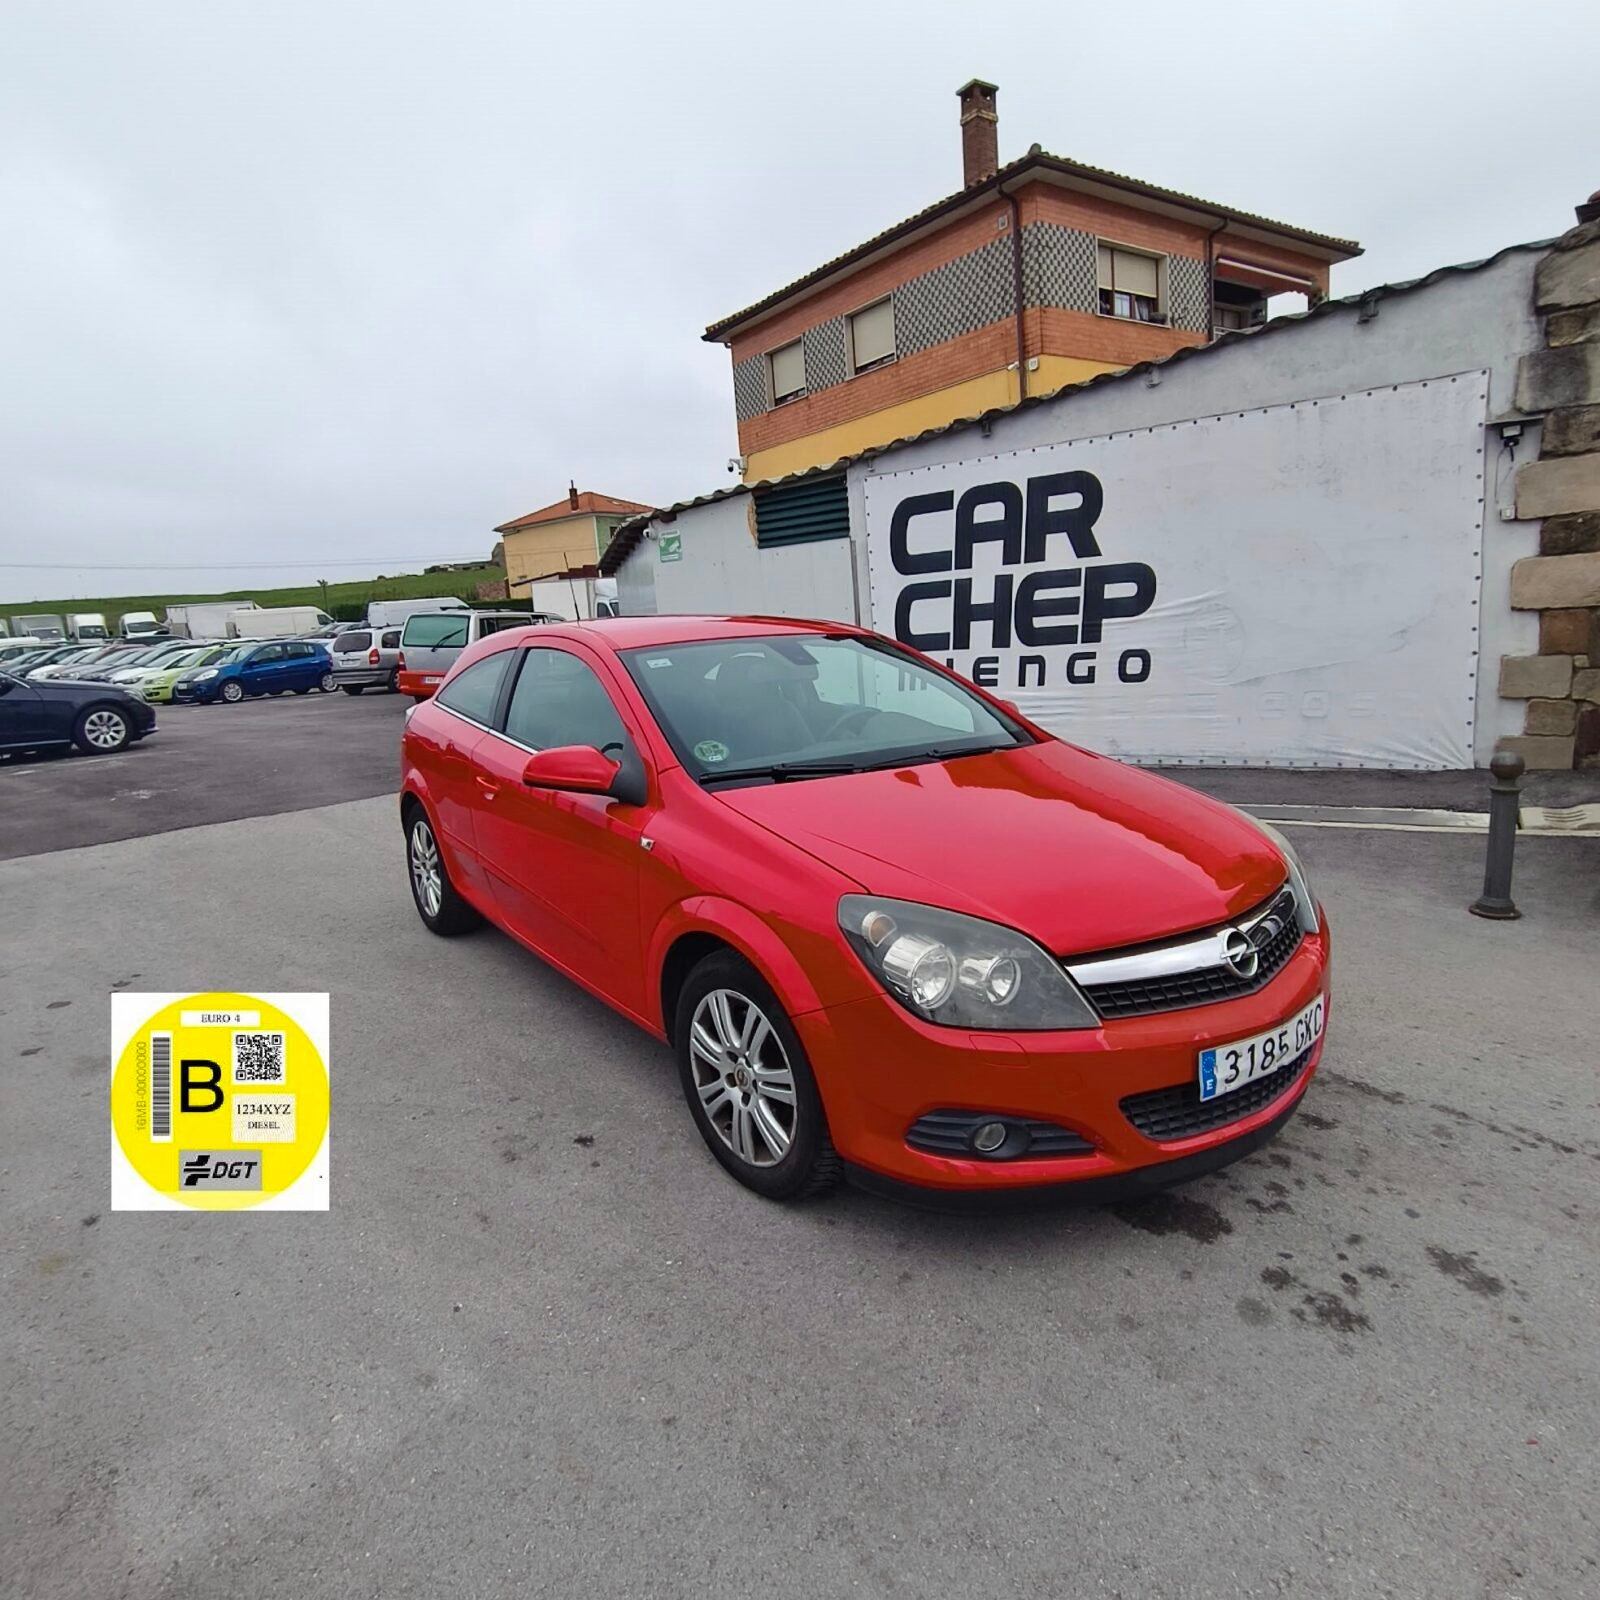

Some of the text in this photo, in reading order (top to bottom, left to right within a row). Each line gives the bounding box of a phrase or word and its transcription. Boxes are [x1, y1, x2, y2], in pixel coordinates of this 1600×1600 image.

[890, 470, 1104, 576] CAR
[894, 562, 1157, 652] CHEP
[1206, 1079, 1214, 1091] E
[1224, 1003, 1322, 1085] 3185 GKC
